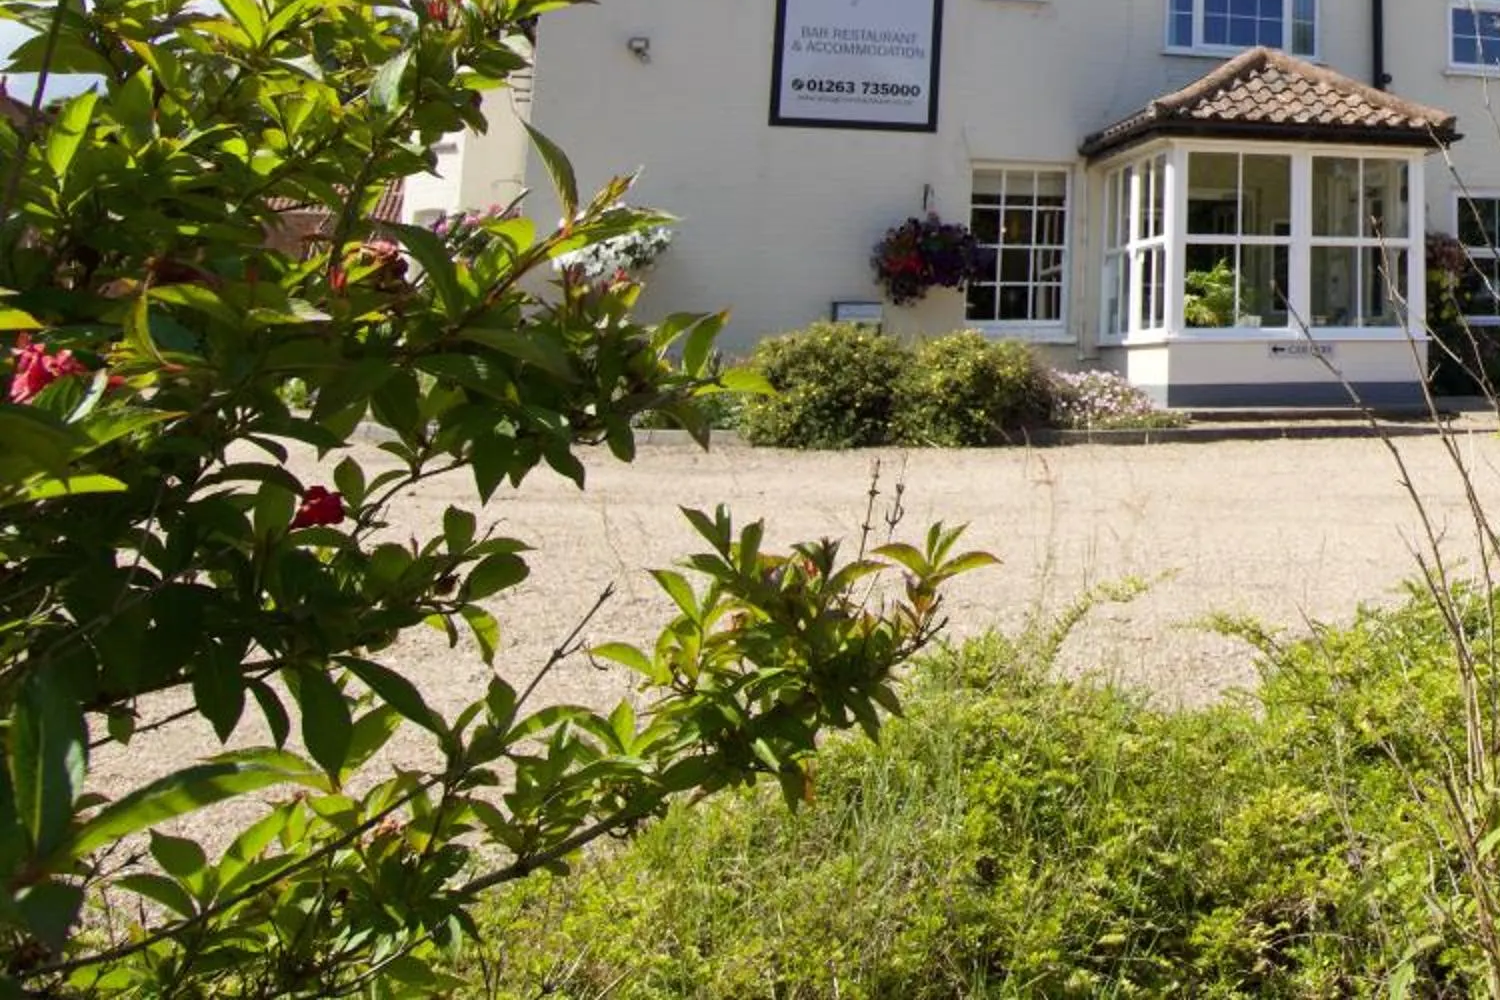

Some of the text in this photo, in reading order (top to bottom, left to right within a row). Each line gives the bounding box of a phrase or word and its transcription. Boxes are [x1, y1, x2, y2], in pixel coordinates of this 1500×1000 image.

[801, 26, 919, 45] BAR RESTAURANT
[791, 40, 926, 59] & ACCOMMODATION
[806, 79, 922, 98] 01263 735000
